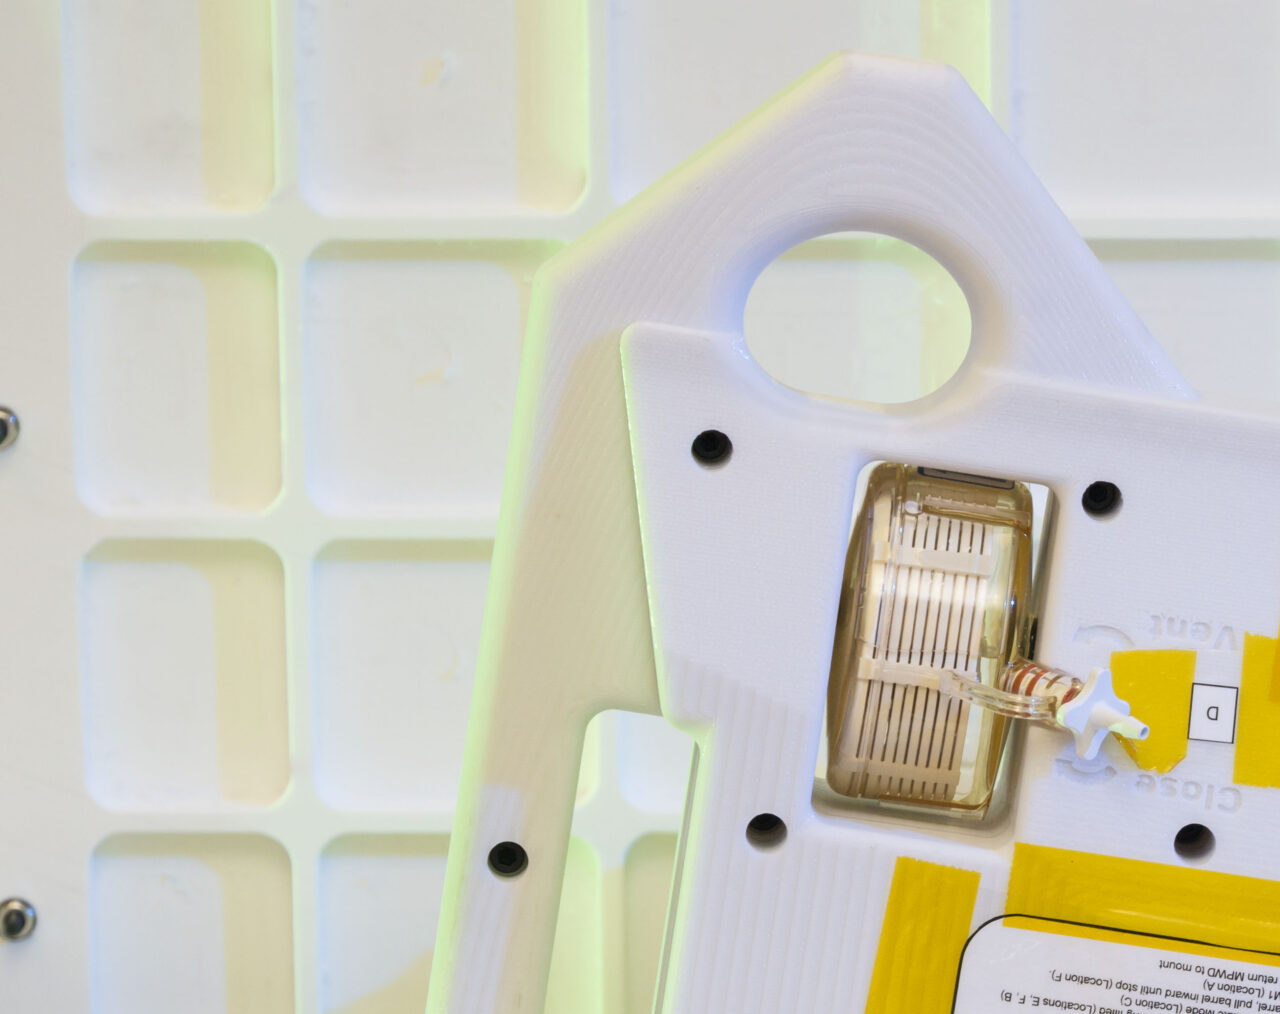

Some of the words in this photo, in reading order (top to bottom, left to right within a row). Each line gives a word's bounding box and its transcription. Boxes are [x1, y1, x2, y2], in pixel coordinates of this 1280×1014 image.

[1151, 614, 1236, 650] Vent
[1206, 705, 1220, 722] D
[1135, 774, 1243, 814] Close
[1157, 958, 1193, 972] mount
[1193, 964, 1205, 976] to
[1205, 966, 1245, 982] MPWD
[1246, 972, 1279, 985] return
